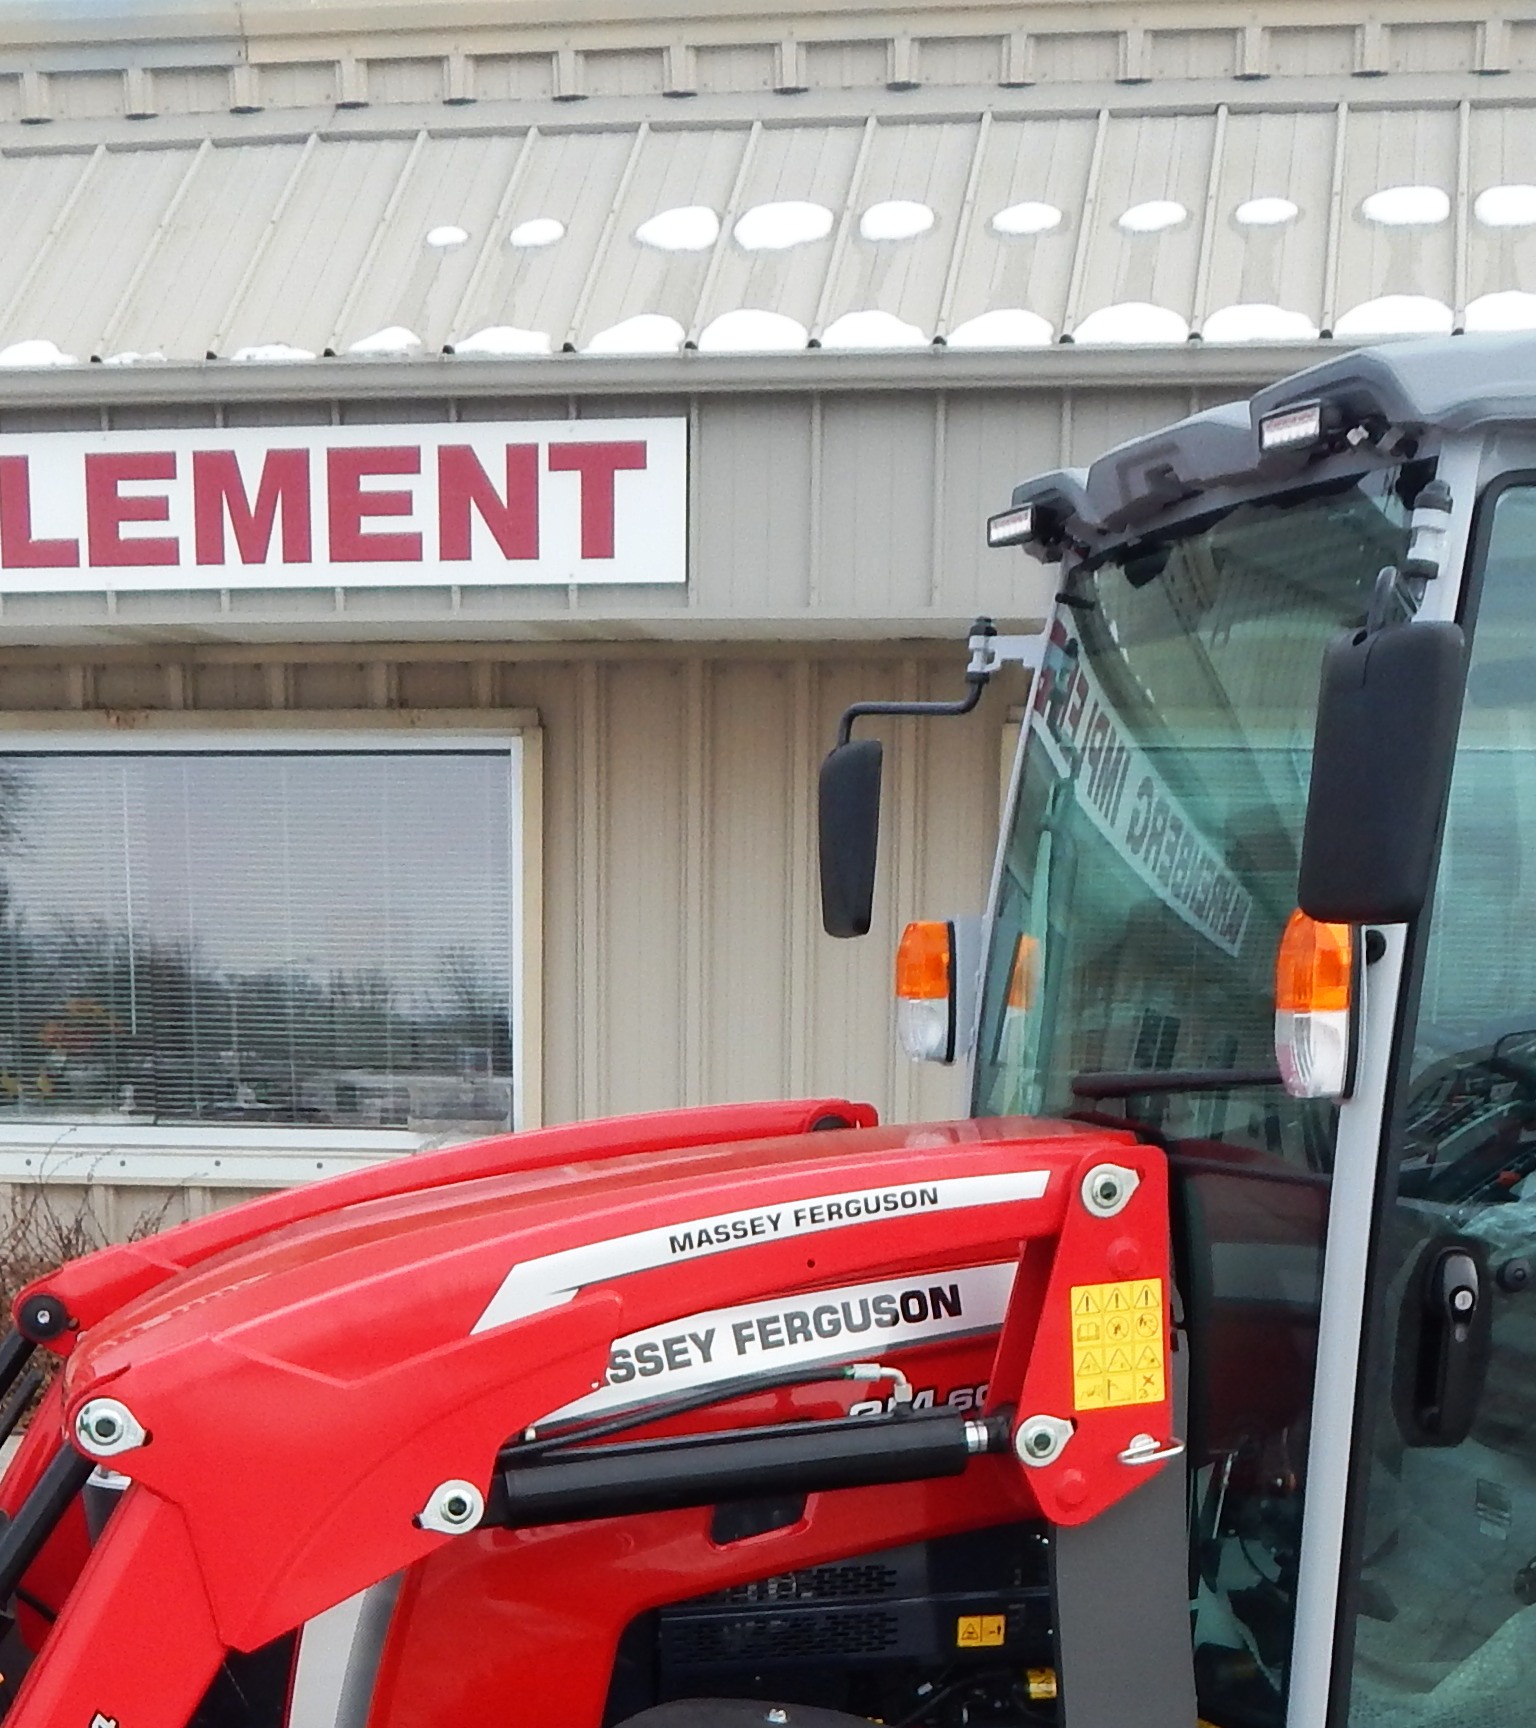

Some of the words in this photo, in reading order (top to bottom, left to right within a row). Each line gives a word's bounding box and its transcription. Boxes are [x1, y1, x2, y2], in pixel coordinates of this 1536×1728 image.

[669, 1212, 782, 1254] MASSEY
[794, 1187, 939, 1227] FERGUSON
[604, 1327, 716, 1388] SSEY
[731, 1284, 963, 1356] FERGUSON
